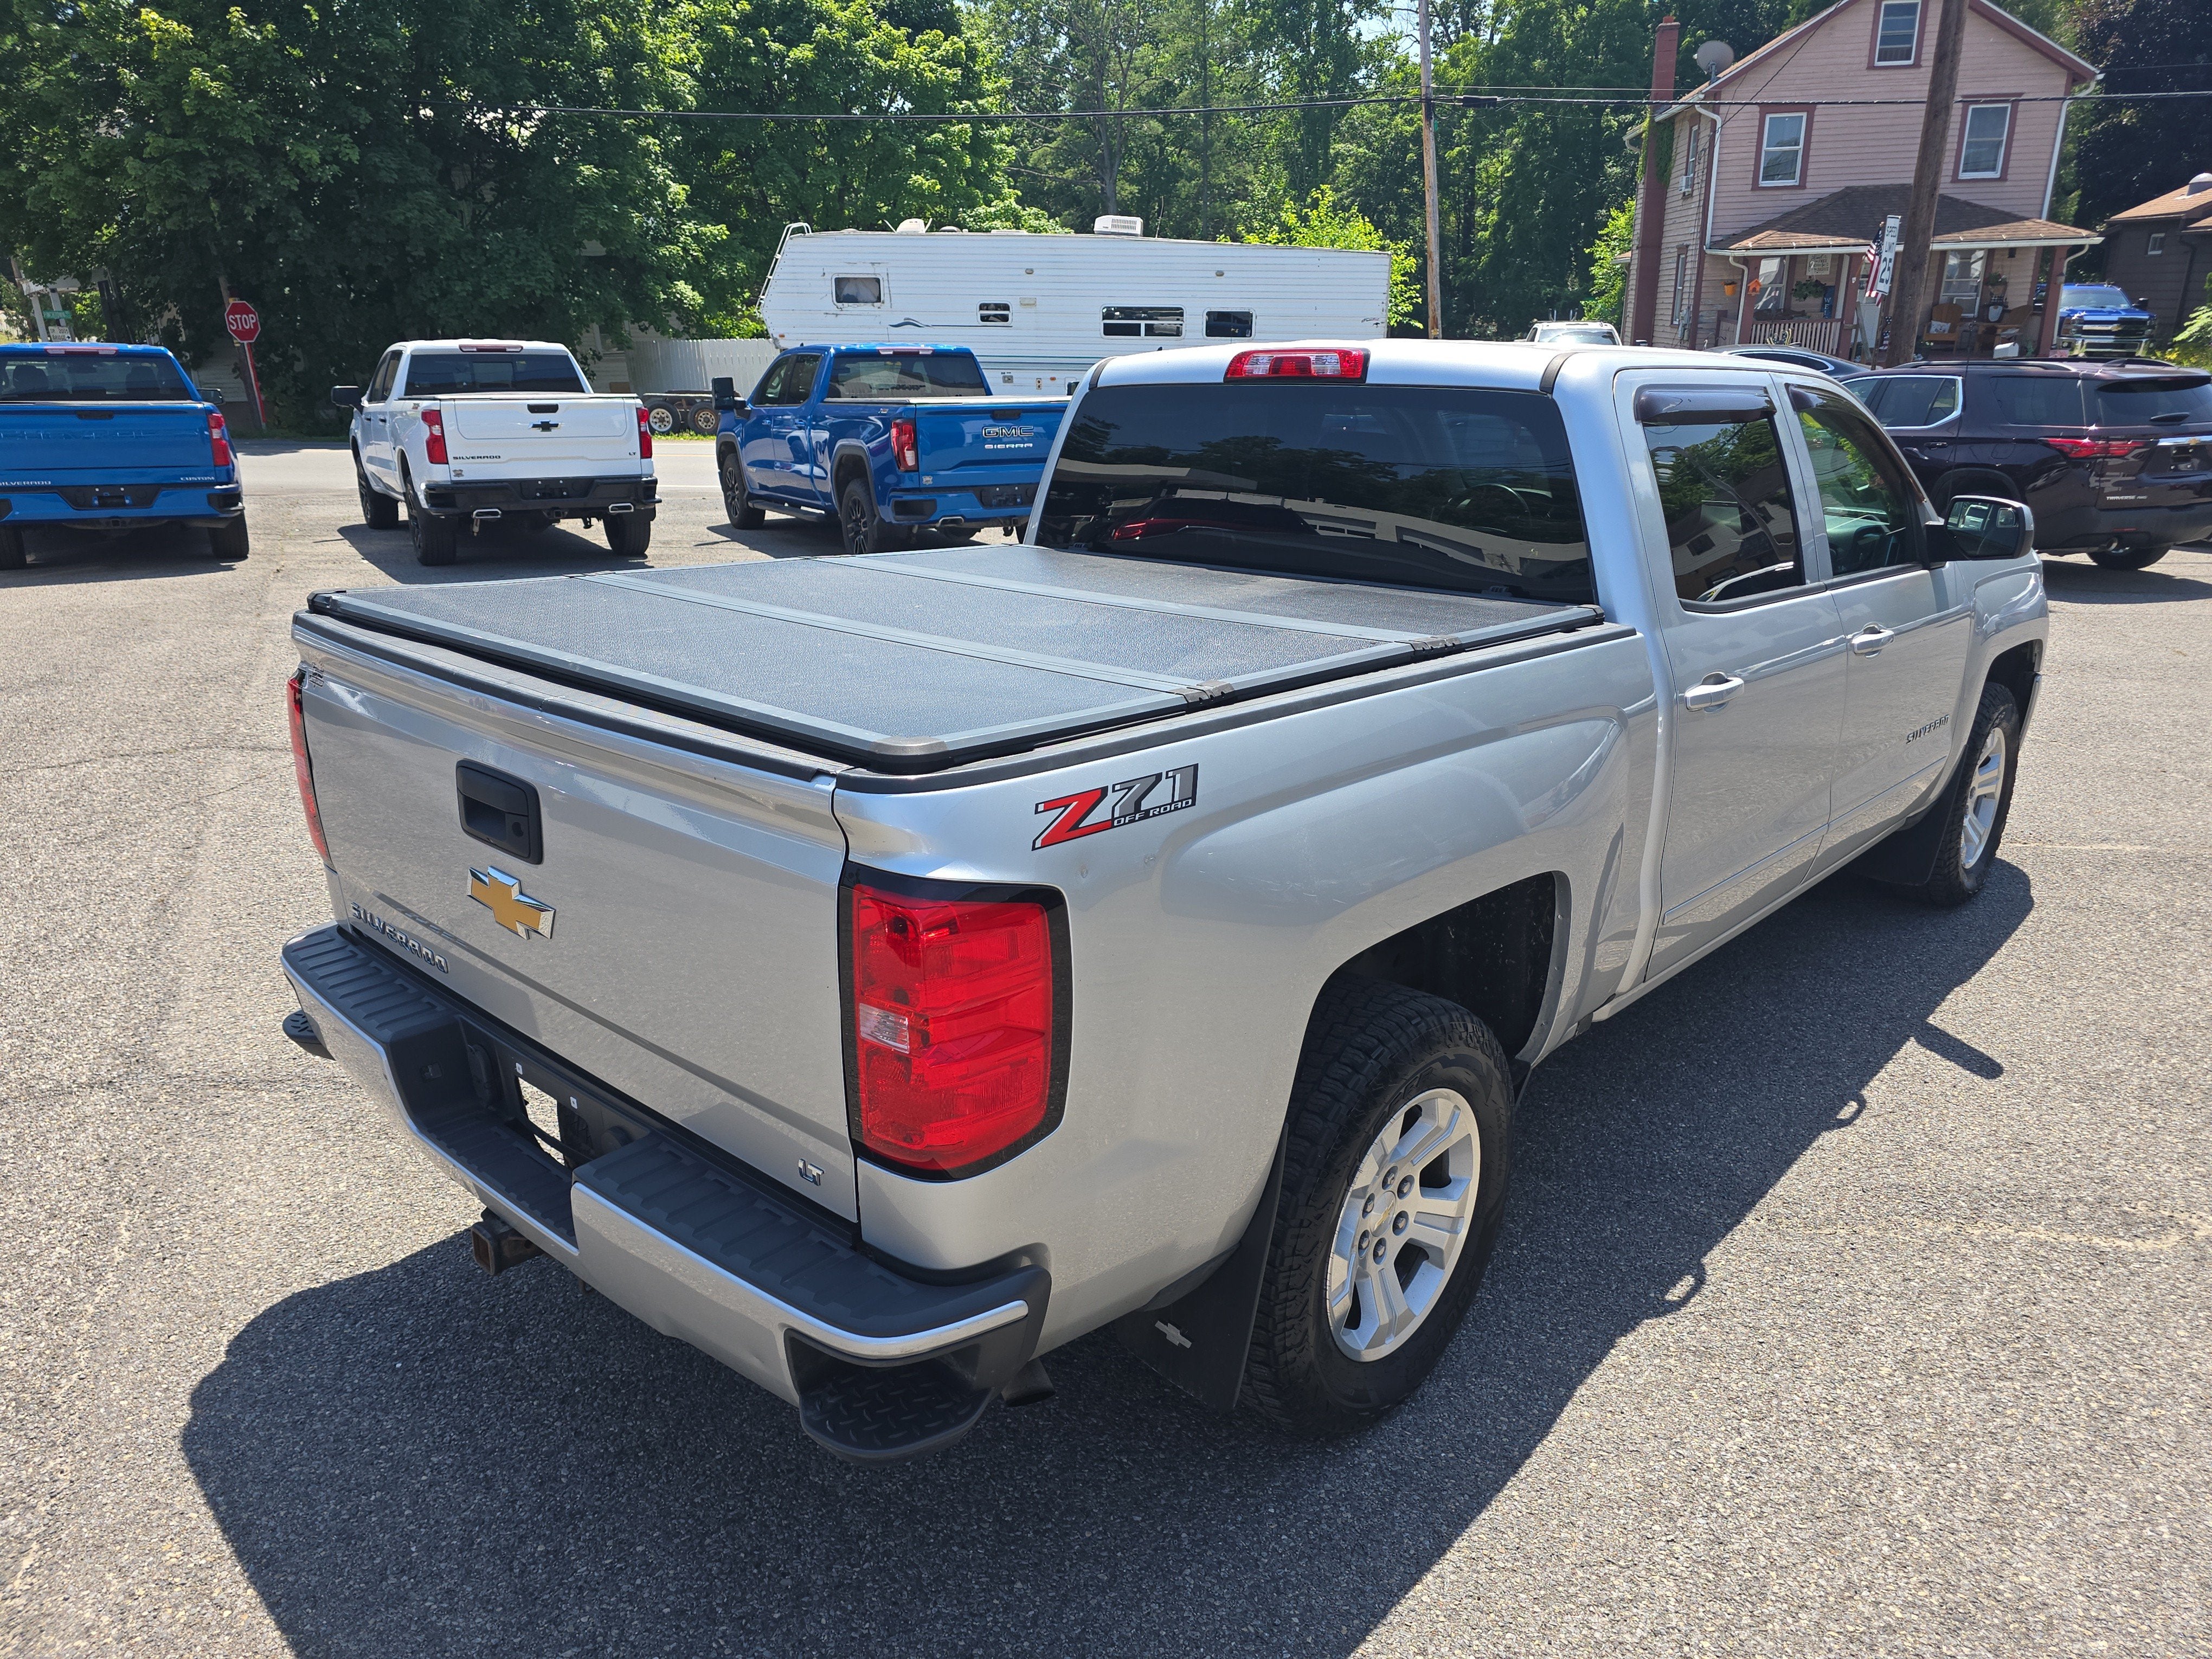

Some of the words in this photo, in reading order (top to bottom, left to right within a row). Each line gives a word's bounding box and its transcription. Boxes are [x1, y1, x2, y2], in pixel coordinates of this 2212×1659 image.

[1886, 226, 1898, 237] SPEED
[1885, 241, 1895, 253] LIMIT
[1879, 257, 1892, 285] 25
[228, 314, 256, 330] STOP
[982, 426, 1034, 438] GMC
[1906, 713, 1950, 745] SILVERADO
[1032, 763, 1199, 851] Z71
[1114, 811, 1145, 827] OFF
[1149, 799, 1192, 816] ROAD
[351, 902, 449, 974] SILVERADO
[798, 1158, 825, 1186] LT
